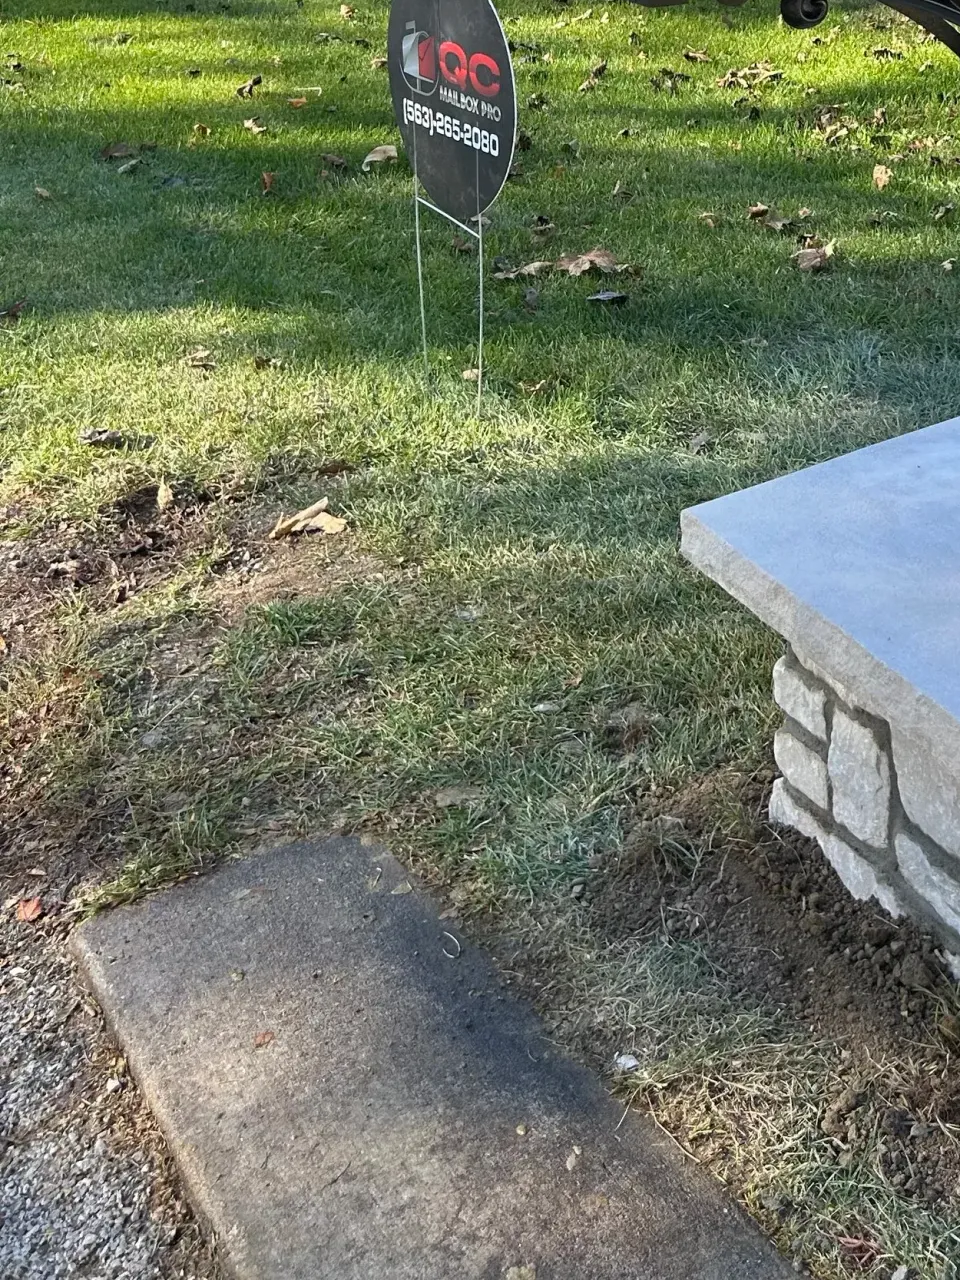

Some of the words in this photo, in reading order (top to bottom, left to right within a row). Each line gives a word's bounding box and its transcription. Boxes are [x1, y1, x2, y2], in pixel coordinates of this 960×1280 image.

[438, 41, 501, 97] QC
[402, 97, 500, 158] (563)-265-2080
[439, 85, 480, 116] MAILBOX
[481, 99, 502, 122] PRO
